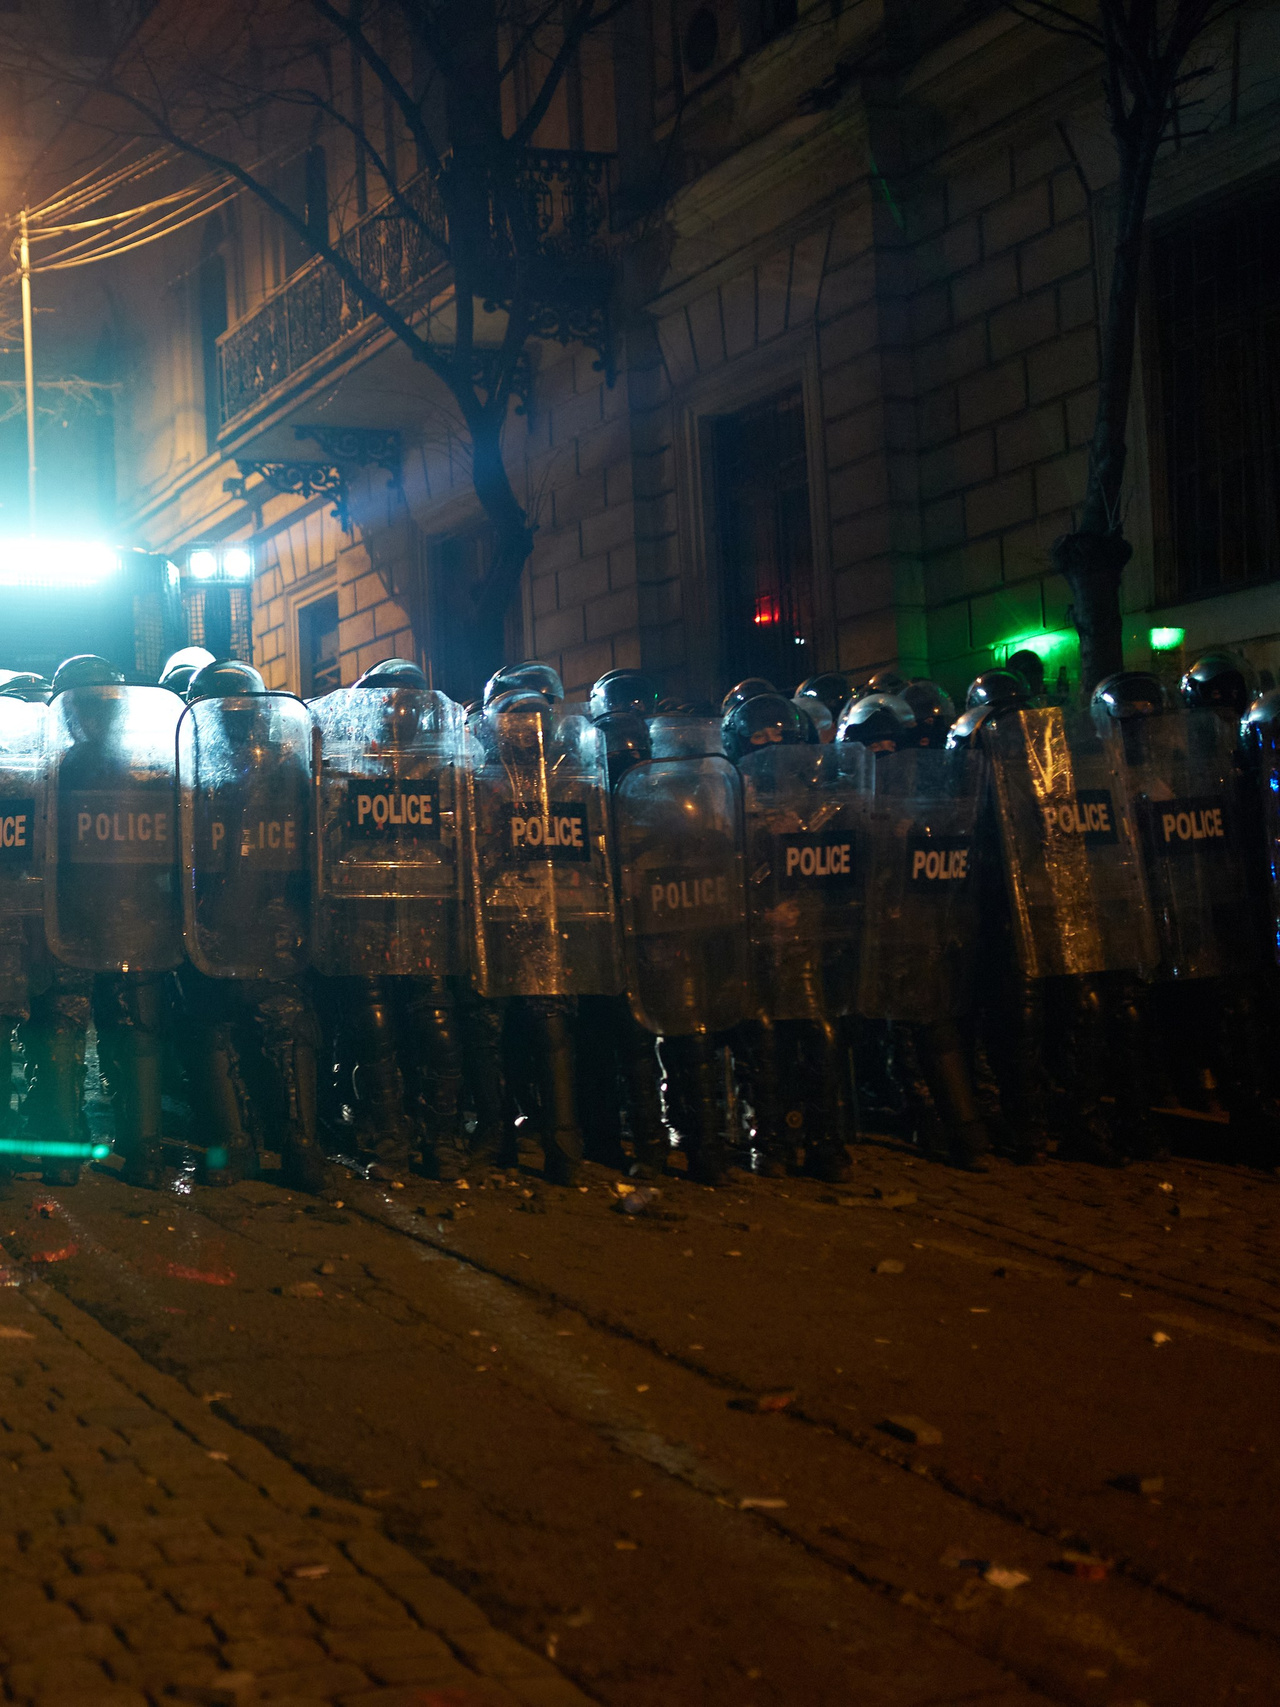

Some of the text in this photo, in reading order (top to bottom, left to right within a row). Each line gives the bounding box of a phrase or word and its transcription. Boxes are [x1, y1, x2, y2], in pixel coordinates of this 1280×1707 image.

[357, 794, 433, 825] POLICE
[1043, 803, 1111, 833] POLICE
[1162, 808, 1224, 842] POLICE
[77, 812, 167, 841] POLICE
[211, 821, 296, 851] PICE
[510, 816, 584, 848] POLICE
[786, 844, 851, 877] POLICE
[912, 849, 968, 880] POLICE
